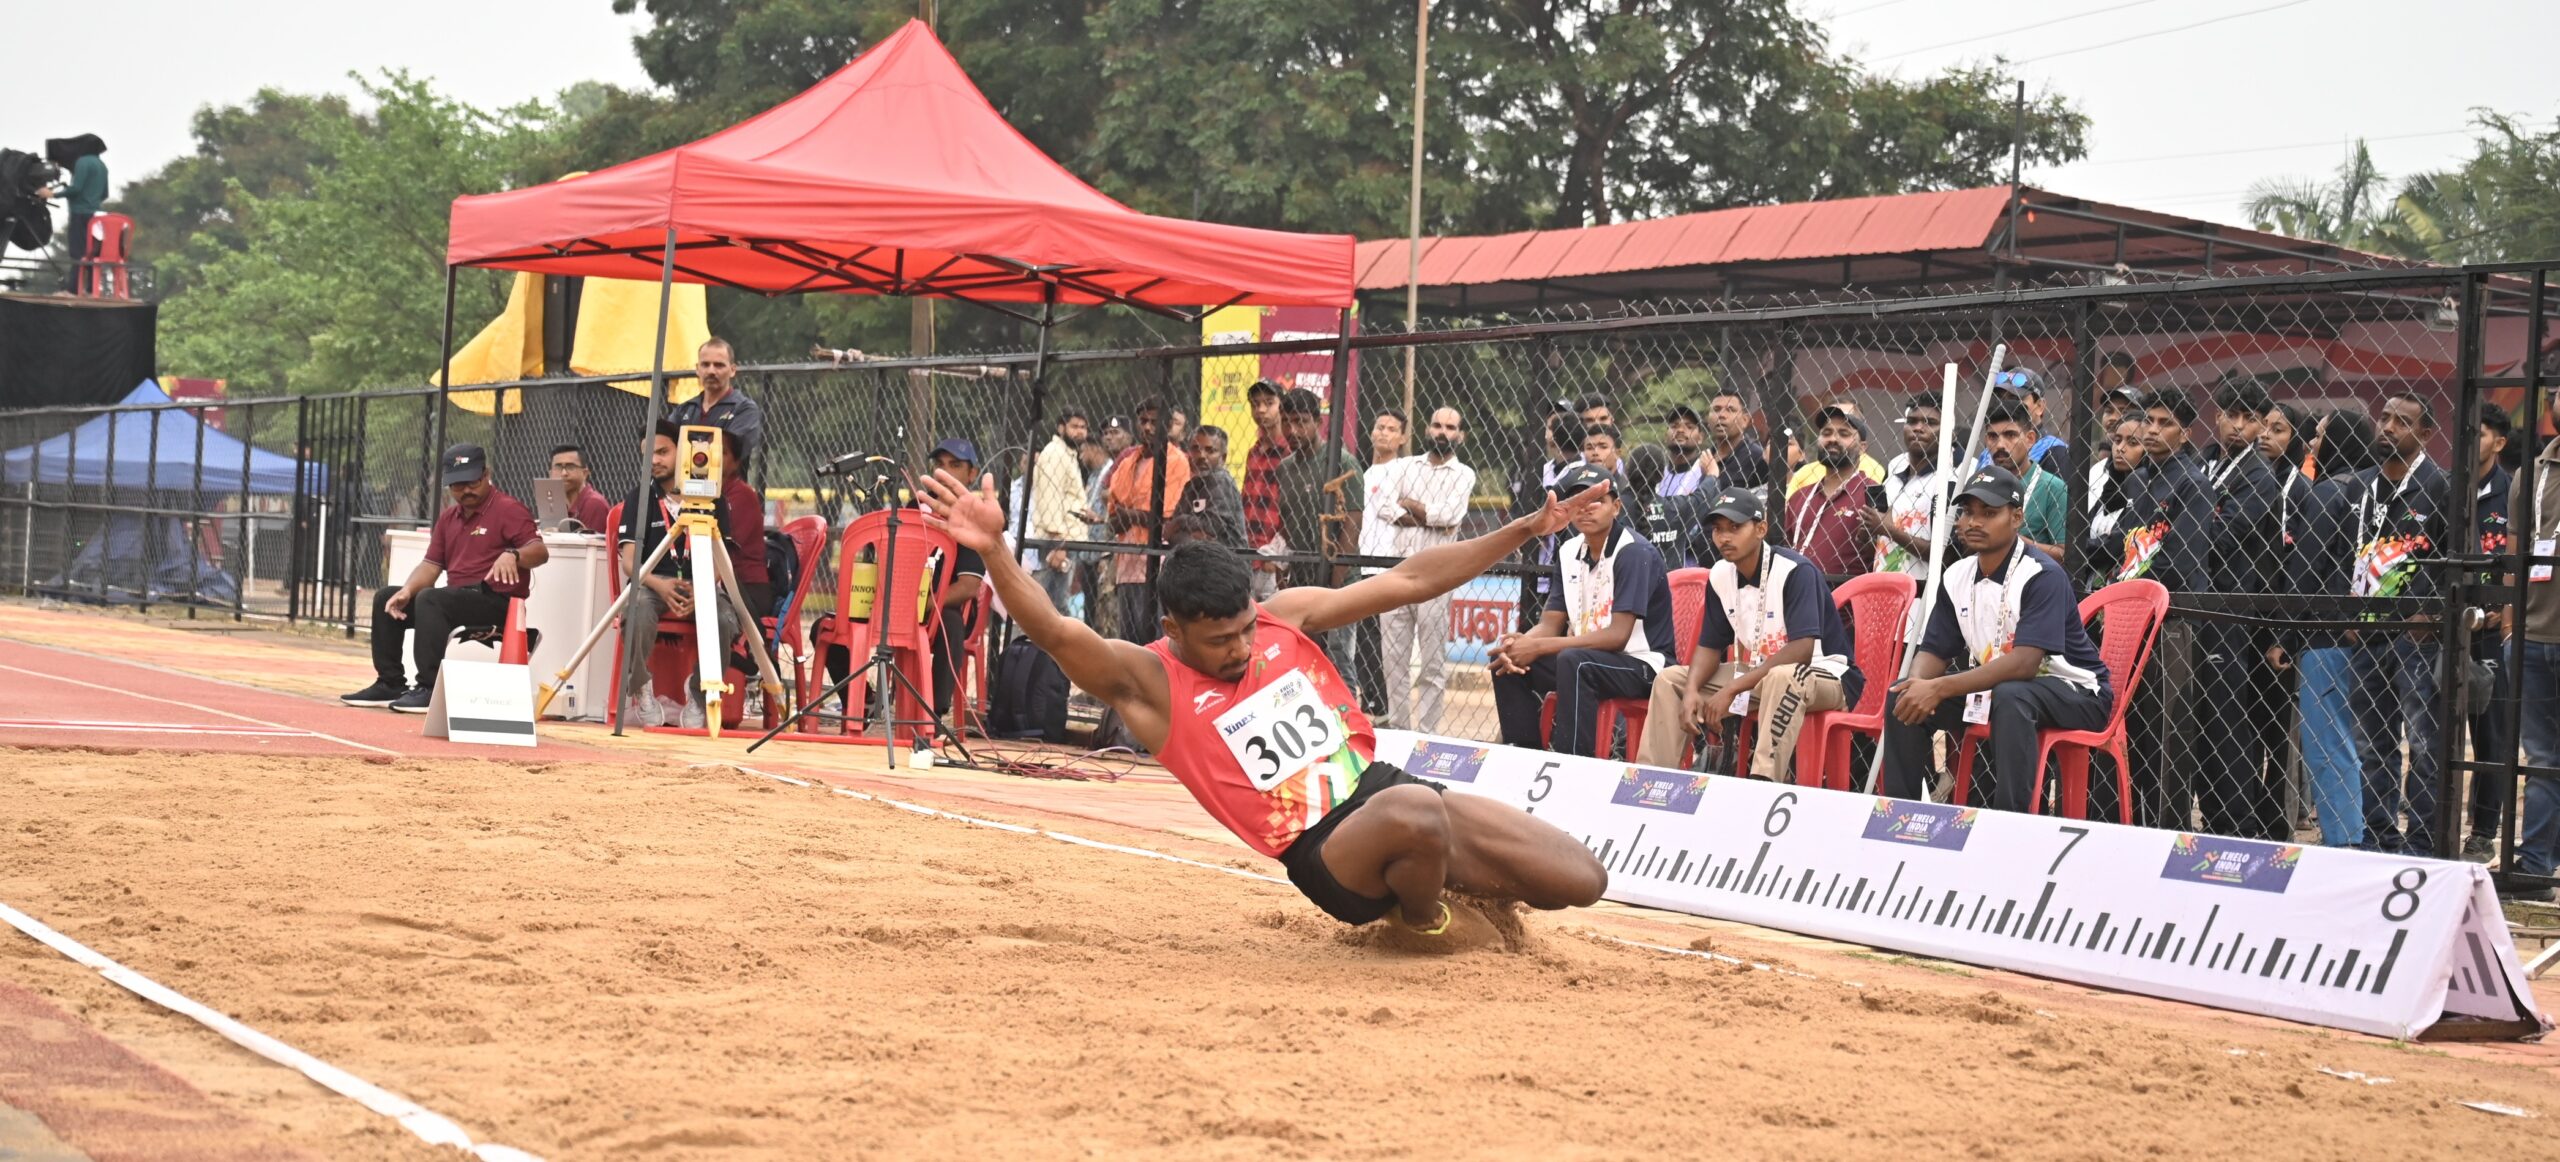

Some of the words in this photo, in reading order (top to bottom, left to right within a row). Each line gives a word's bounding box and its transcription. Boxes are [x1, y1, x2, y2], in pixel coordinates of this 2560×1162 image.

[1246, 704, 1329, 781] 303
[1527, 761, 1561, 802] 5
[1653, 780, 1675, 790] KHELO
[1647, 788, 1668, 799] INDIA
[1763, 791, 1798, 837] 6
[1911, 813, 1936, 824] KHELO
[1906, 822, 1929, 833] INDIA
[2047, 825, 2089, 875] 7
[2220, 850, 2250, 863] KHELO
[2214, 860, 2242, 872] INDIA
[2381, 867, 2428, 922] 8
